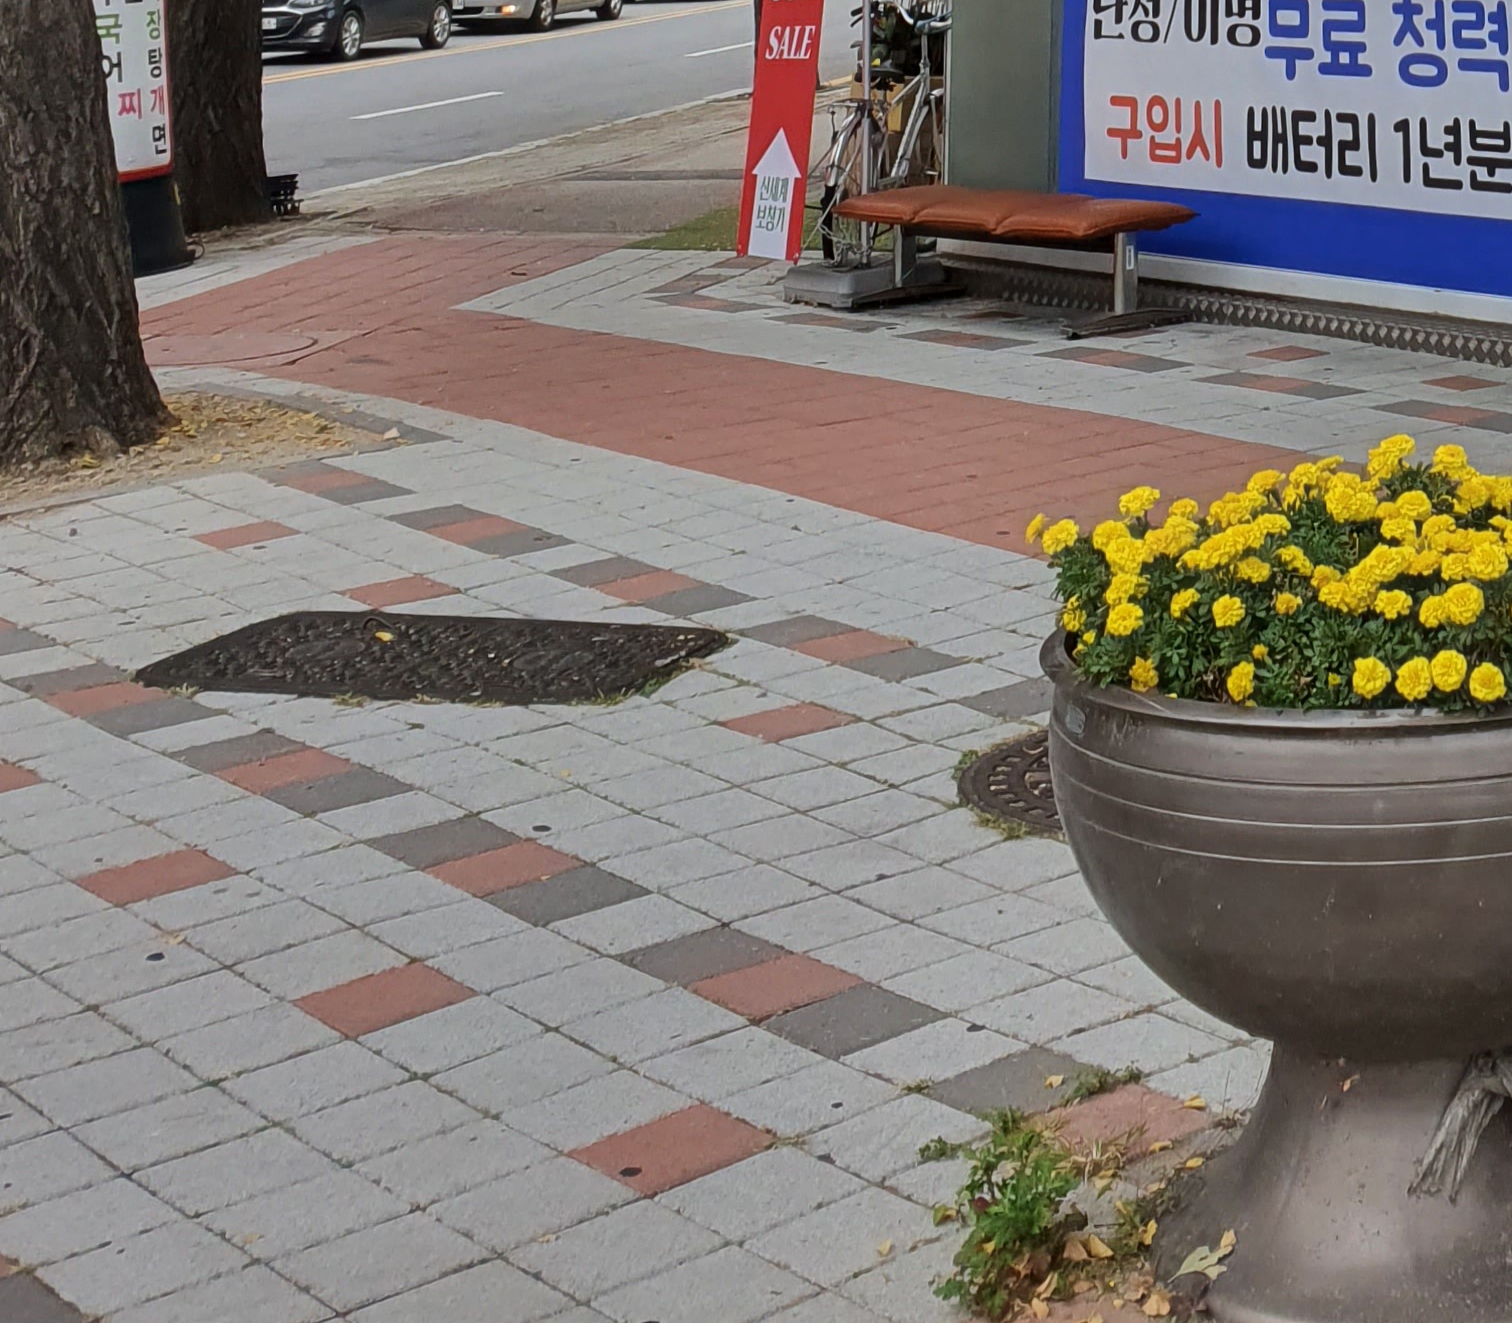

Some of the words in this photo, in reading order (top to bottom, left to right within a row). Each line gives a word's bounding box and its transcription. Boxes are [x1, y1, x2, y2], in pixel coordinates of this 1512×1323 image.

[765, 25, 816, 60] SALE
[1106, 93, 1223, 169] 구입시
[1246, 104, 1377, 183] 배터리
[760, 176, 789, 204] 신세계
[755, 205, 785, 233] 보청기
